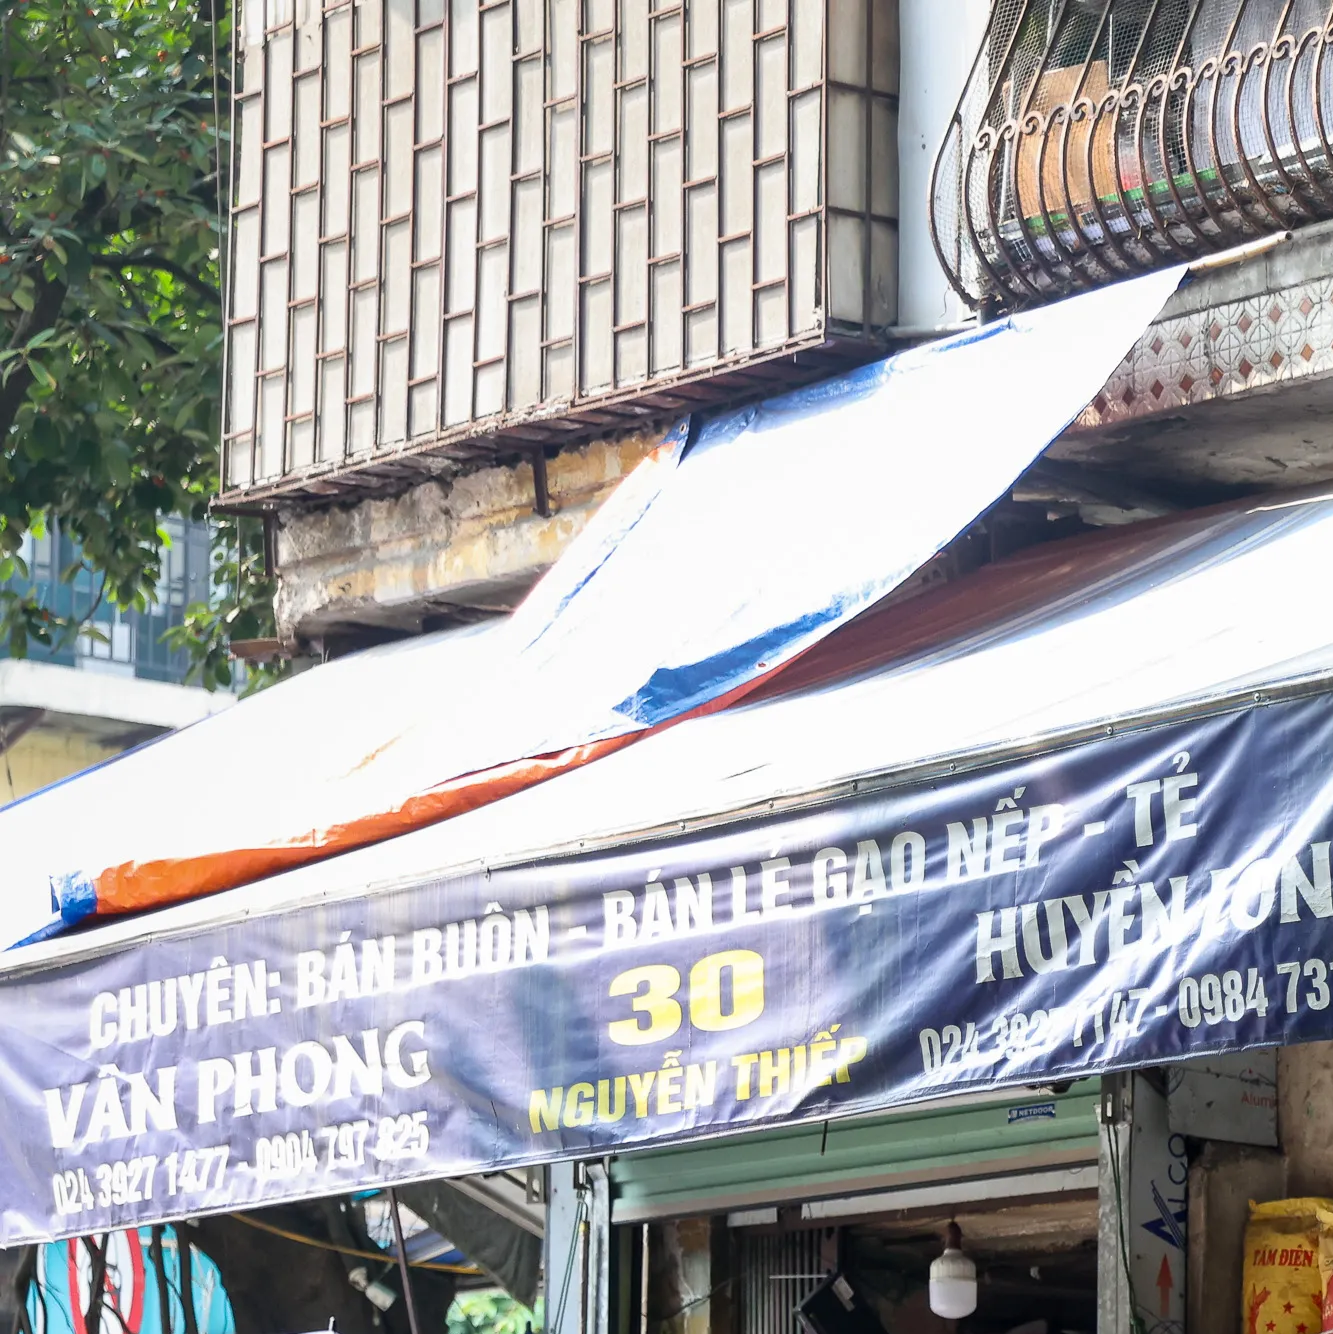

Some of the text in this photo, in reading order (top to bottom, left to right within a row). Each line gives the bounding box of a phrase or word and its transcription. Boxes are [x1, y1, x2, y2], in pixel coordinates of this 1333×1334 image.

[90, 955, 282, 1049] CHUYÊN:
[297, 931, 396, 1009] BÁN
[413, 900, 551, 983] BUÔN
[602, 869, 714, 949] BÁN
[812, 831, 927, 916] GẠO
[947, 786, 1065, 882] NẾP
[1127, 750, 1199, 849] TẺ
[975, 858, 1190, 985] HUYỀN
[609, 948, 765, 1046] 30
[1178, 967, 1269, 1028] 0984
[42, 1020, 432, 1152] VÂN PHONG
[528, 1024, 867, 1134] NGUYỄN THIẾP
[53, 1167, 96, 1217] 024
[98, 1155, 157, 1208] 3927
[164, 1145, 231, 1196] 1477
[256, 1129, 318, 1186] 0904
[321, 1119, 371, 1172] 797
